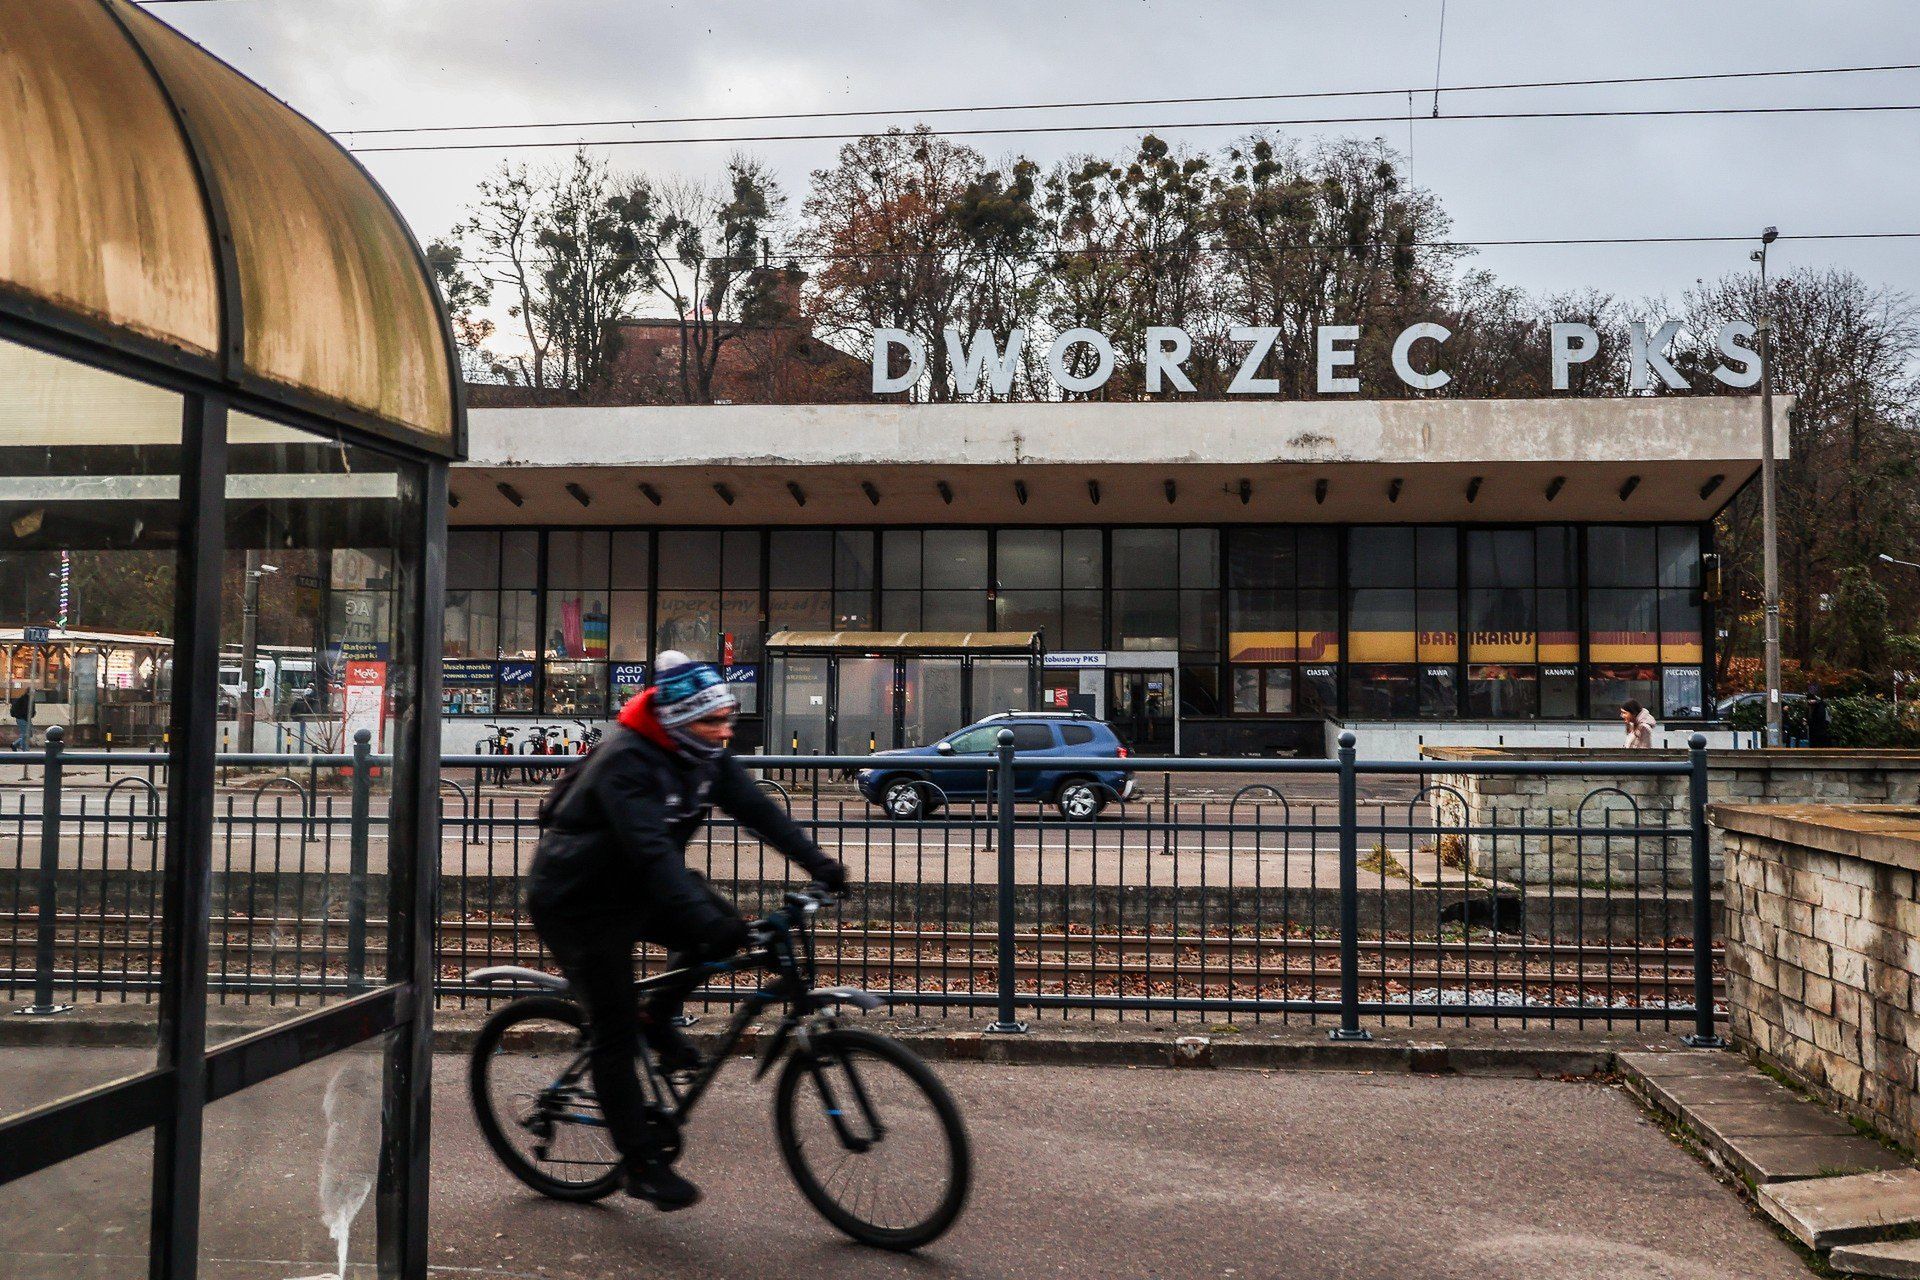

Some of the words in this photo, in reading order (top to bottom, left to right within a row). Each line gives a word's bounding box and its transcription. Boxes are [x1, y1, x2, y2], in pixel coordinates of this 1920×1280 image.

[872, 322, 1452, 394] DWORZEC
[1551, 320, 1763, 390] PKS
[1419, 632, 1457, 645] BAR
[1470, 632, 1534, 645] IKARUS
[343, 643, 377, 651] Baterie
[342, 653, 377, 661] Zegarki
[1044, 655, 1082, 664] tobusowy
[616, 666, 643, 674] AGD
[617, 675, 642, 683] RTV
